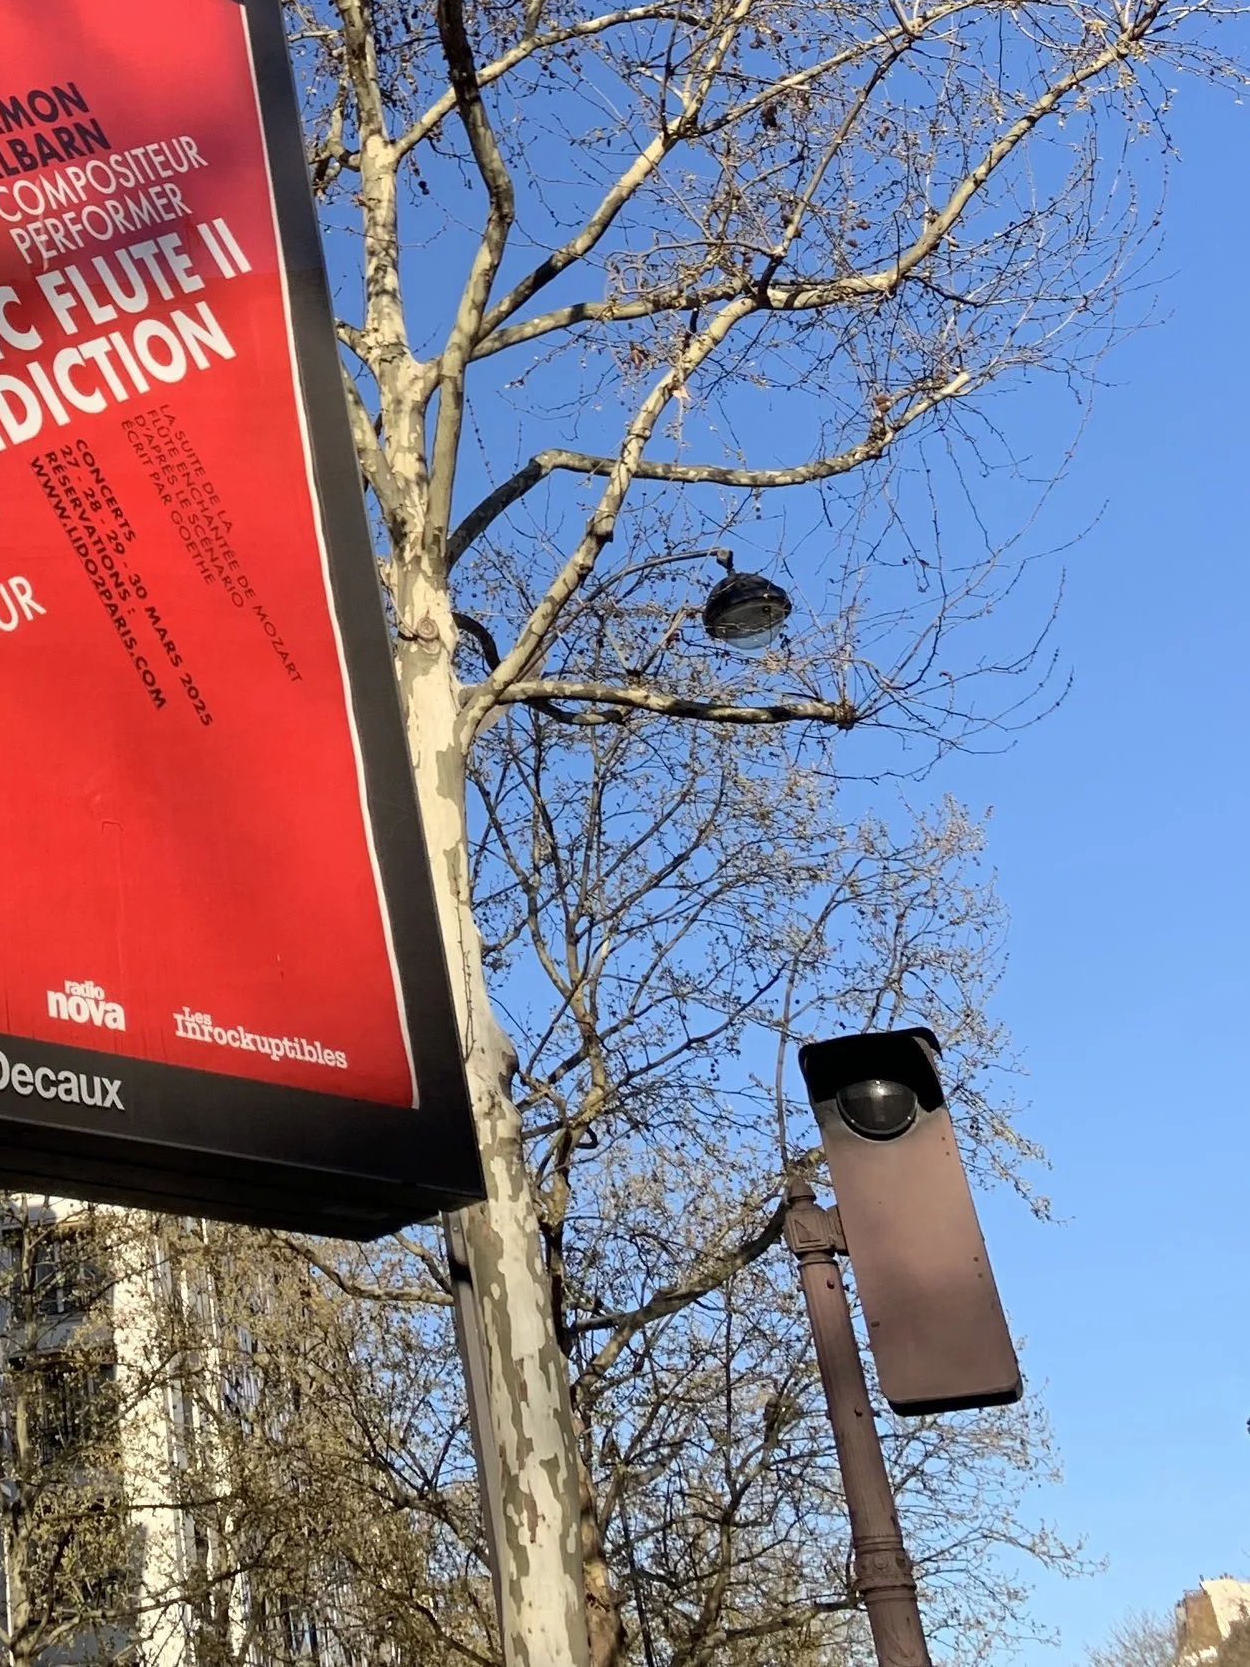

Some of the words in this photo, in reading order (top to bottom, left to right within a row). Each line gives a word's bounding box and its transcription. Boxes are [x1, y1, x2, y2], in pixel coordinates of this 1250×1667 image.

[9, 183, 192, 265] PERFORMER
[35, 232, 205, 335] FLUTE
[196, 217, 252, 279] II
[44, 451, 132, 602] RÉSERVATIONS
[76, 439, 137, 542] CONCERTS
[121, 420, 153, 466] ÉCRIT
[148, 472, 172, 506] PAR
[170, 510, 216, 586] GOETHE
[134, 415, 178, 485] D'APRÈS
[175, 490, 192, 509] LE
[188, 513, 244, 608] SCÉNARIO
[159, 404, 176, 427] LA
[175, 430, 206, 478] SUITE
[202, 481, 221, 505] DE
[217, 510, 232, 533] LA
[30, 456, 167, 711] WWW.LIDO2PARIS.COM
[60, 444, 81, 468] 27
[82, 487, 103, 512] 28
[105, 529, 126, 554] 29
[128, 573, 148, 599] 30
[145, 606, 183, 667] MARS
[179, 673, 213, 726] 2025
[147, 410, 179, 458] FLÛTE
[176, 462, 240, 572] ENCHANTÉE
[237, 575, 256, 599] DE
[252, 605, 303, 682] MOZART
[47, 989, 126, 1031] nova
[64, 980, 105, 1001] radio
[173, 1012, 348, 1069] Inrockuptibles
[182, 1006, 212, 1026] Les
